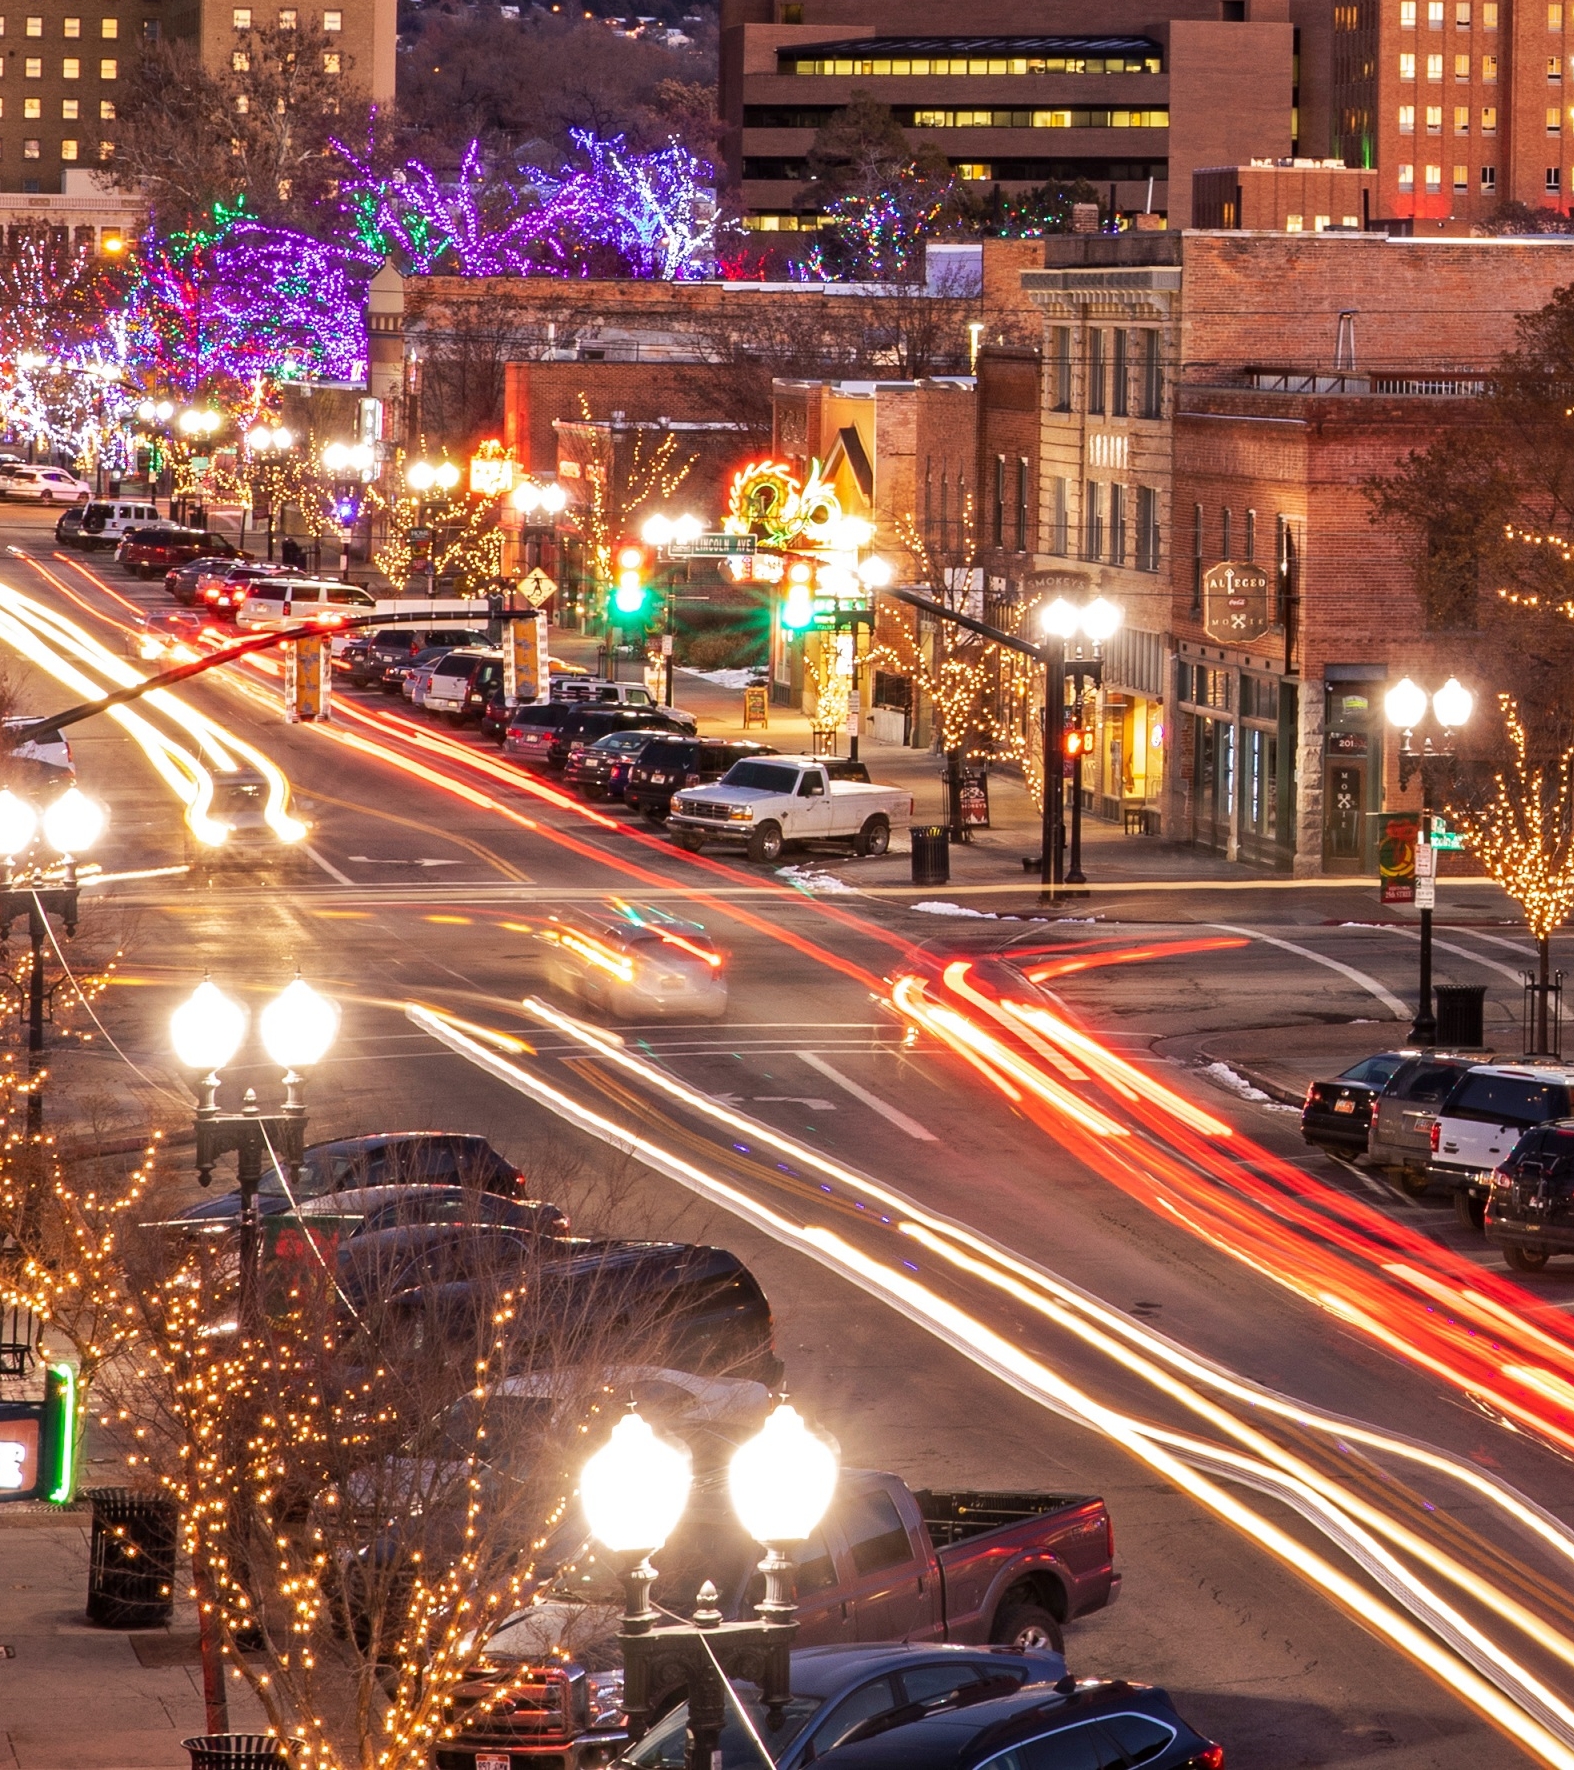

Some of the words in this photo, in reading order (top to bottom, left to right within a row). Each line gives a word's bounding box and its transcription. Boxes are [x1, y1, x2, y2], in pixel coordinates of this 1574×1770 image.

[695, 540, 730, 553] LINCOLN
[736, 540, 755, 553] AVE.
[1027, 576, 1086, 591] SMOKEYS
[1338, 739, 1354, 748] 201
